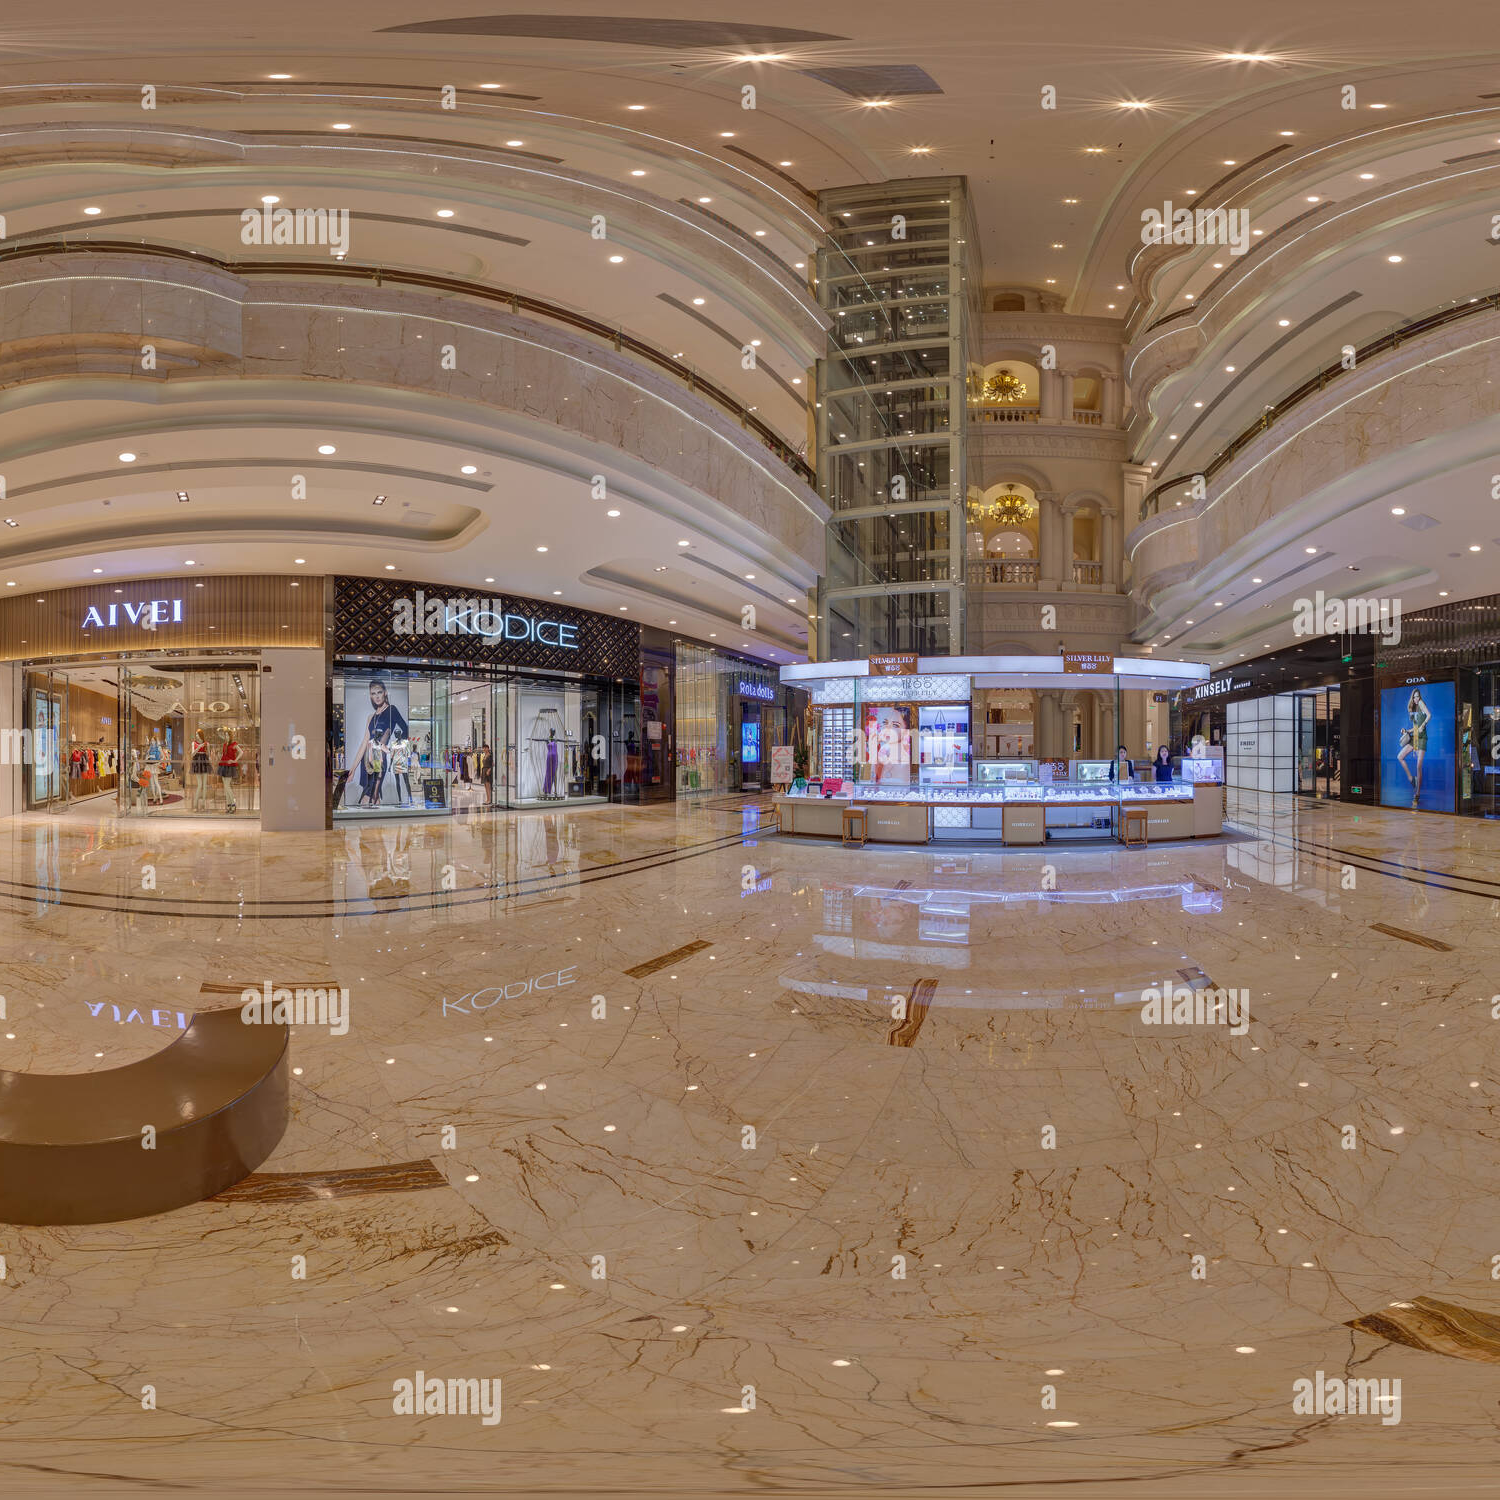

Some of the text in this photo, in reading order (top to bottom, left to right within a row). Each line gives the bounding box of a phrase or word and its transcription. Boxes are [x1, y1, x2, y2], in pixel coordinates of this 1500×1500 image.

[81, 599, 182, 628] AIVEI
[445, 606, 579, 649] KODICE
[870, 656, 915, 665] SILVER LILY
[1195, 677, 1233, 699] XINSELY
[1406, 676, 1426, 685] QDA
